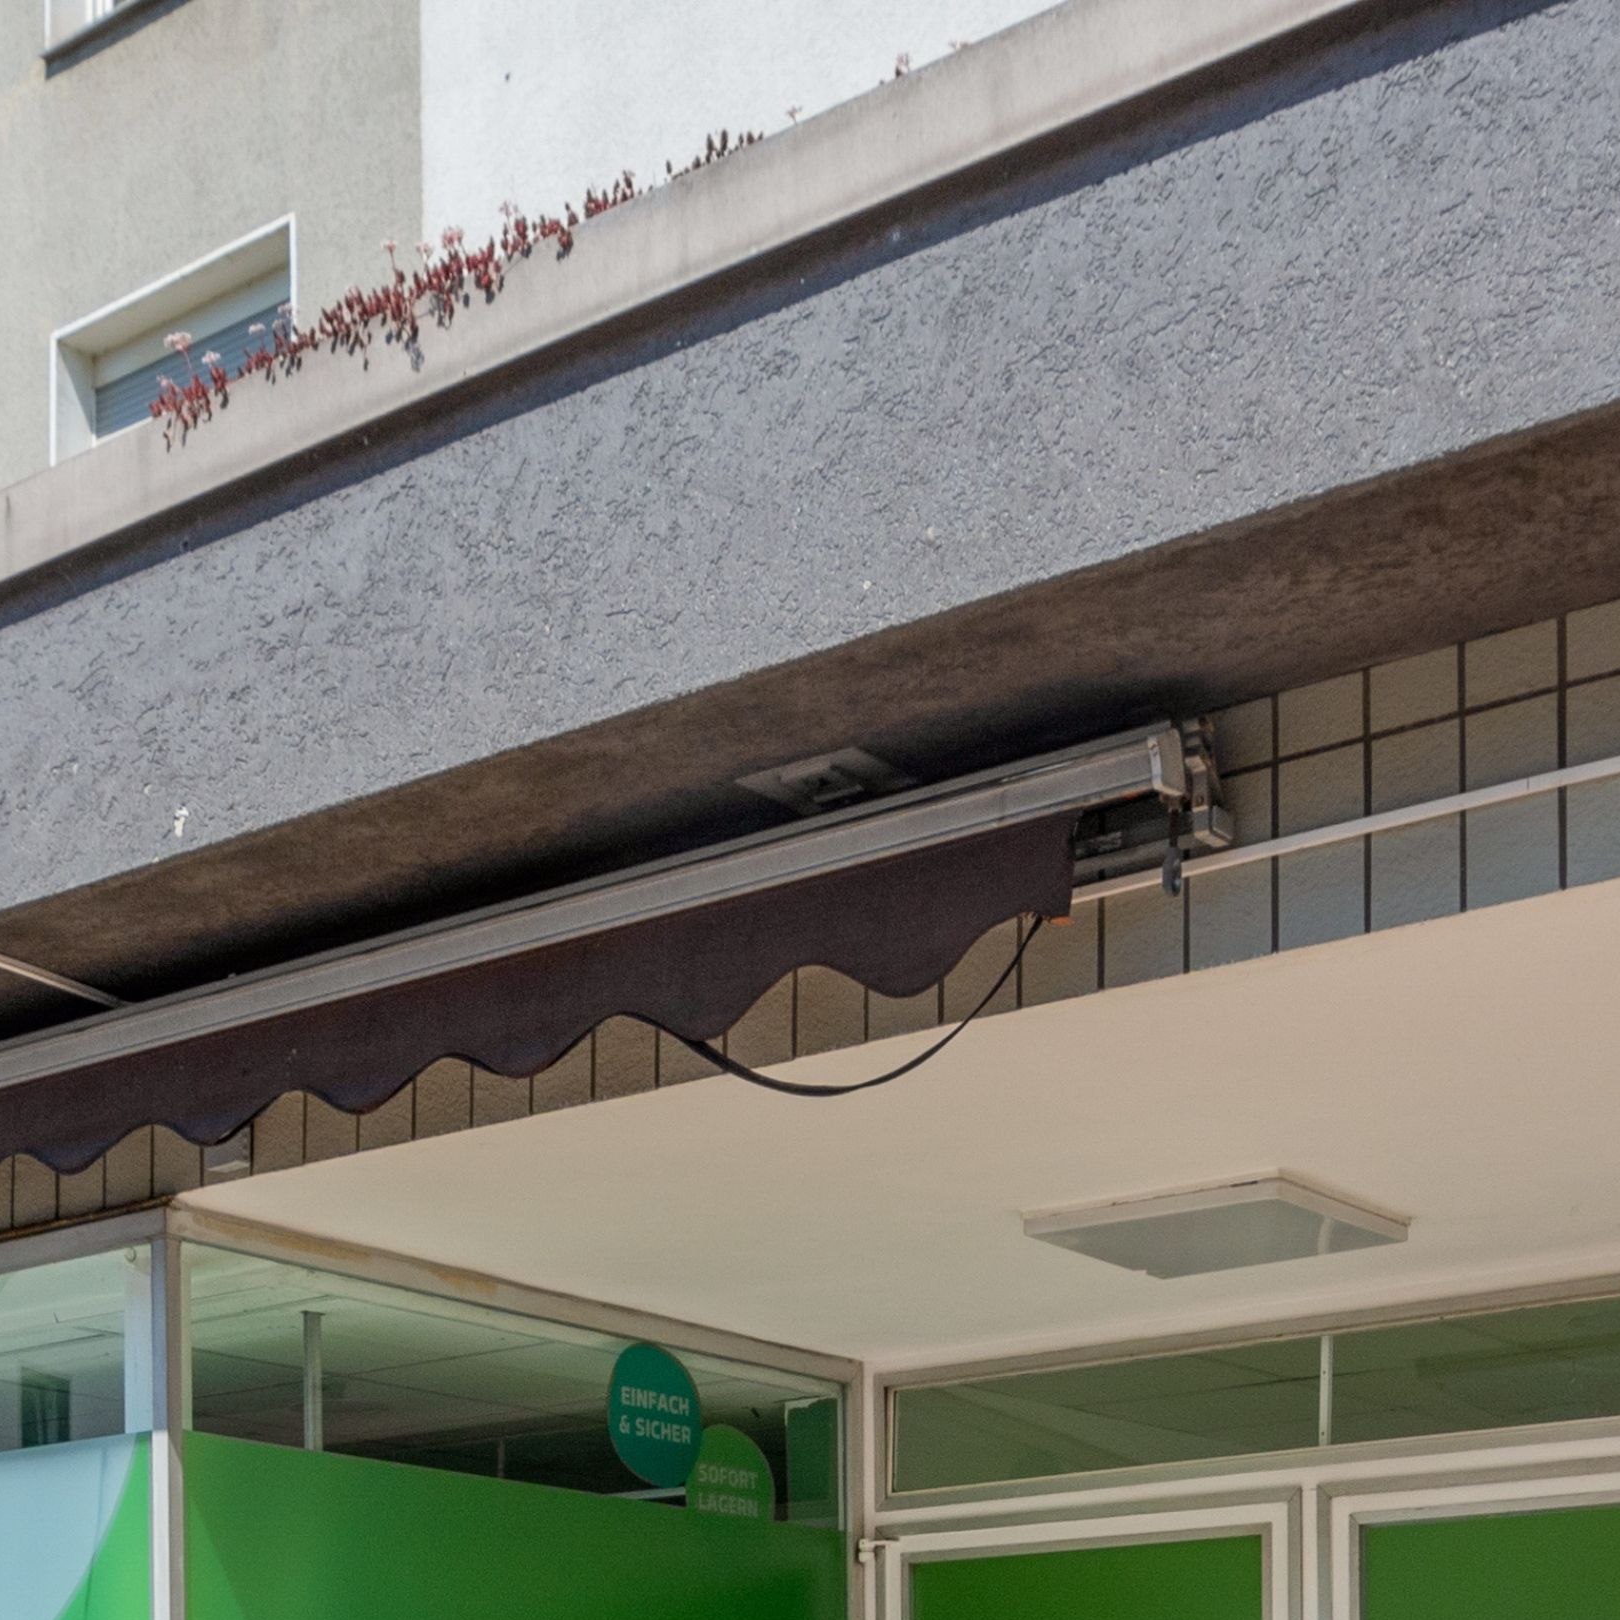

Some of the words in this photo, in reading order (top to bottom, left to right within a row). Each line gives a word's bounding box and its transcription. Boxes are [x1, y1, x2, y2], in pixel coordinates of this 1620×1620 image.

[621, 1386, 689, 1416] EINFACH
[619, 1415, 630, 1434] &
[635, 1417, 691, 1444] SICHER
[698, 1464, 758, 1489] SOFORT
[698, 1493, 758, 1517] LAGERN
